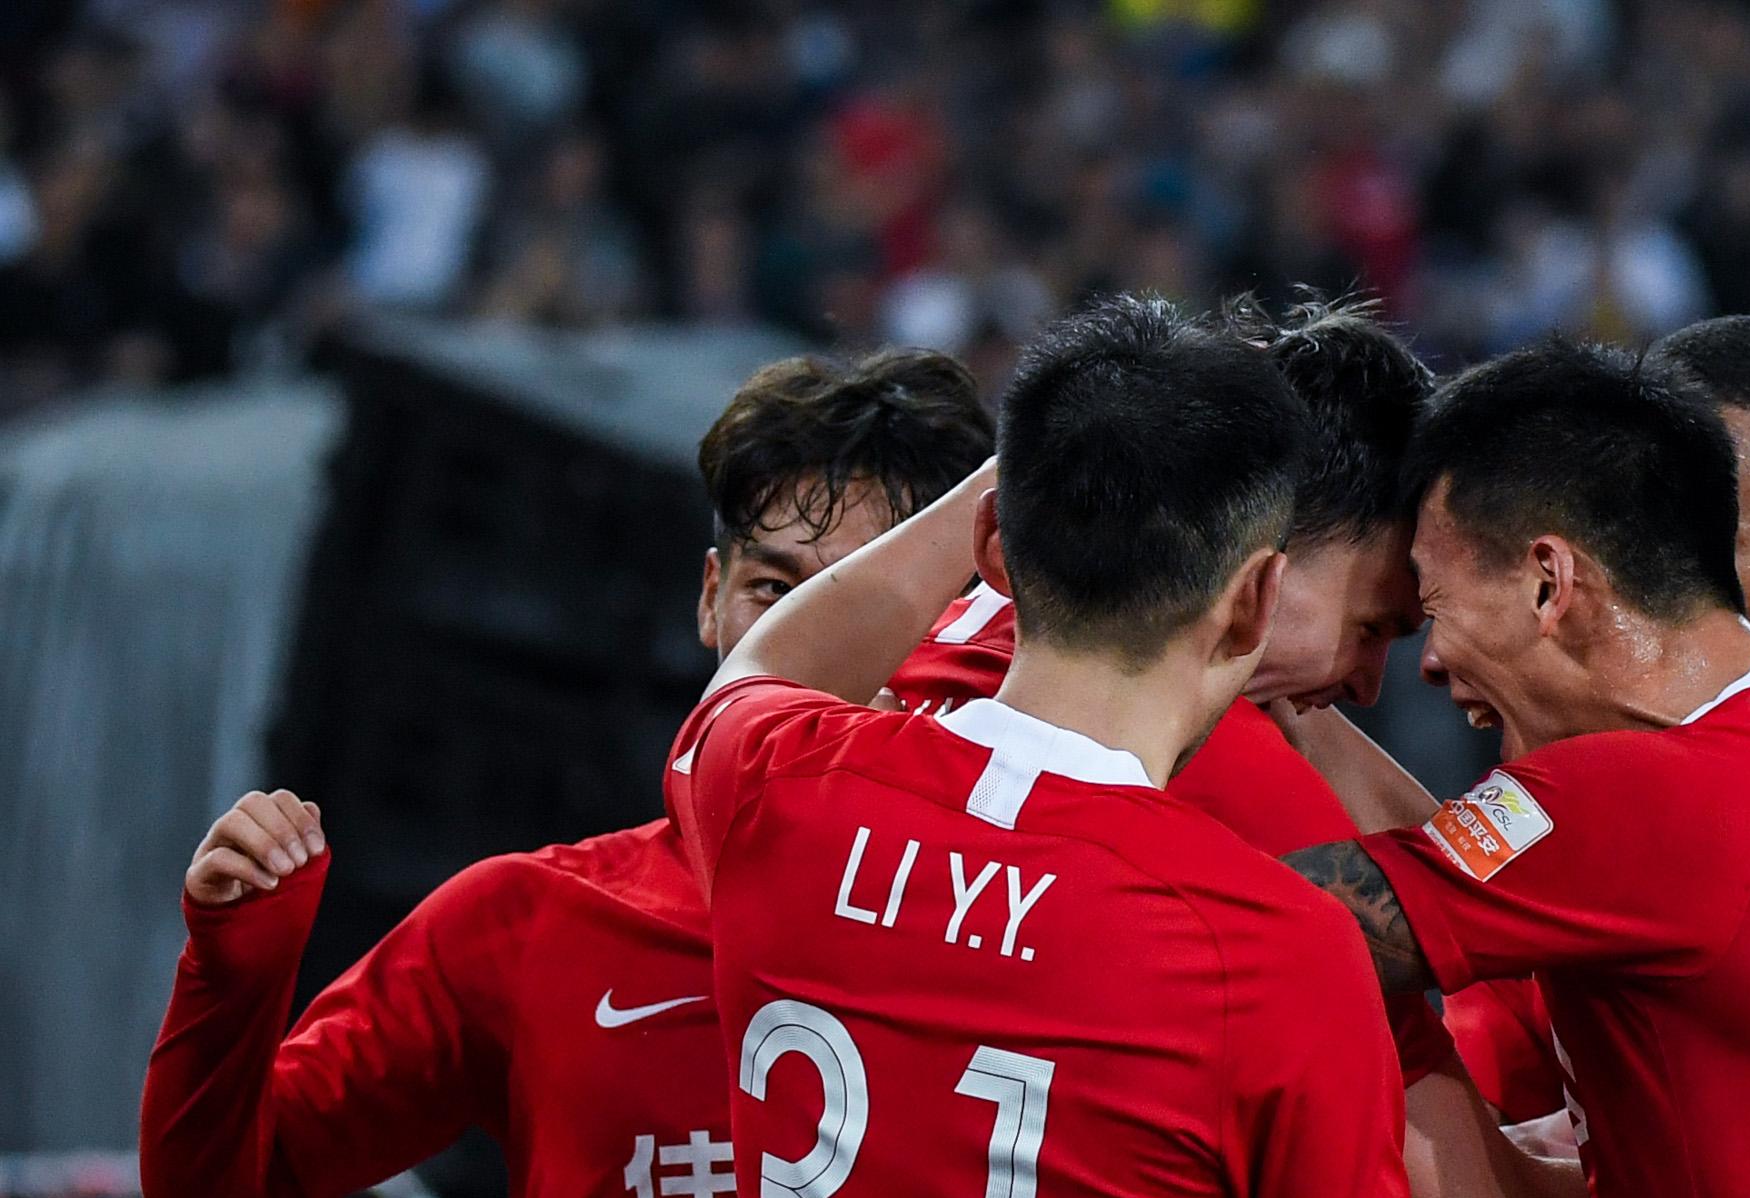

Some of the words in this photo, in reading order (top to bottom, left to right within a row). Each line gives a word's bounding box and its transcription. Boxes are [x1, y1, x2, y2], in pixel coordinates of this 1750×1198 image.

[1448, 800, 1501, 857] 中国平安
[1493, 808, 1513, 832] CSL
[834, 826, 921, 928] LI
[945, 851, 1057, 962] Y.Y.
